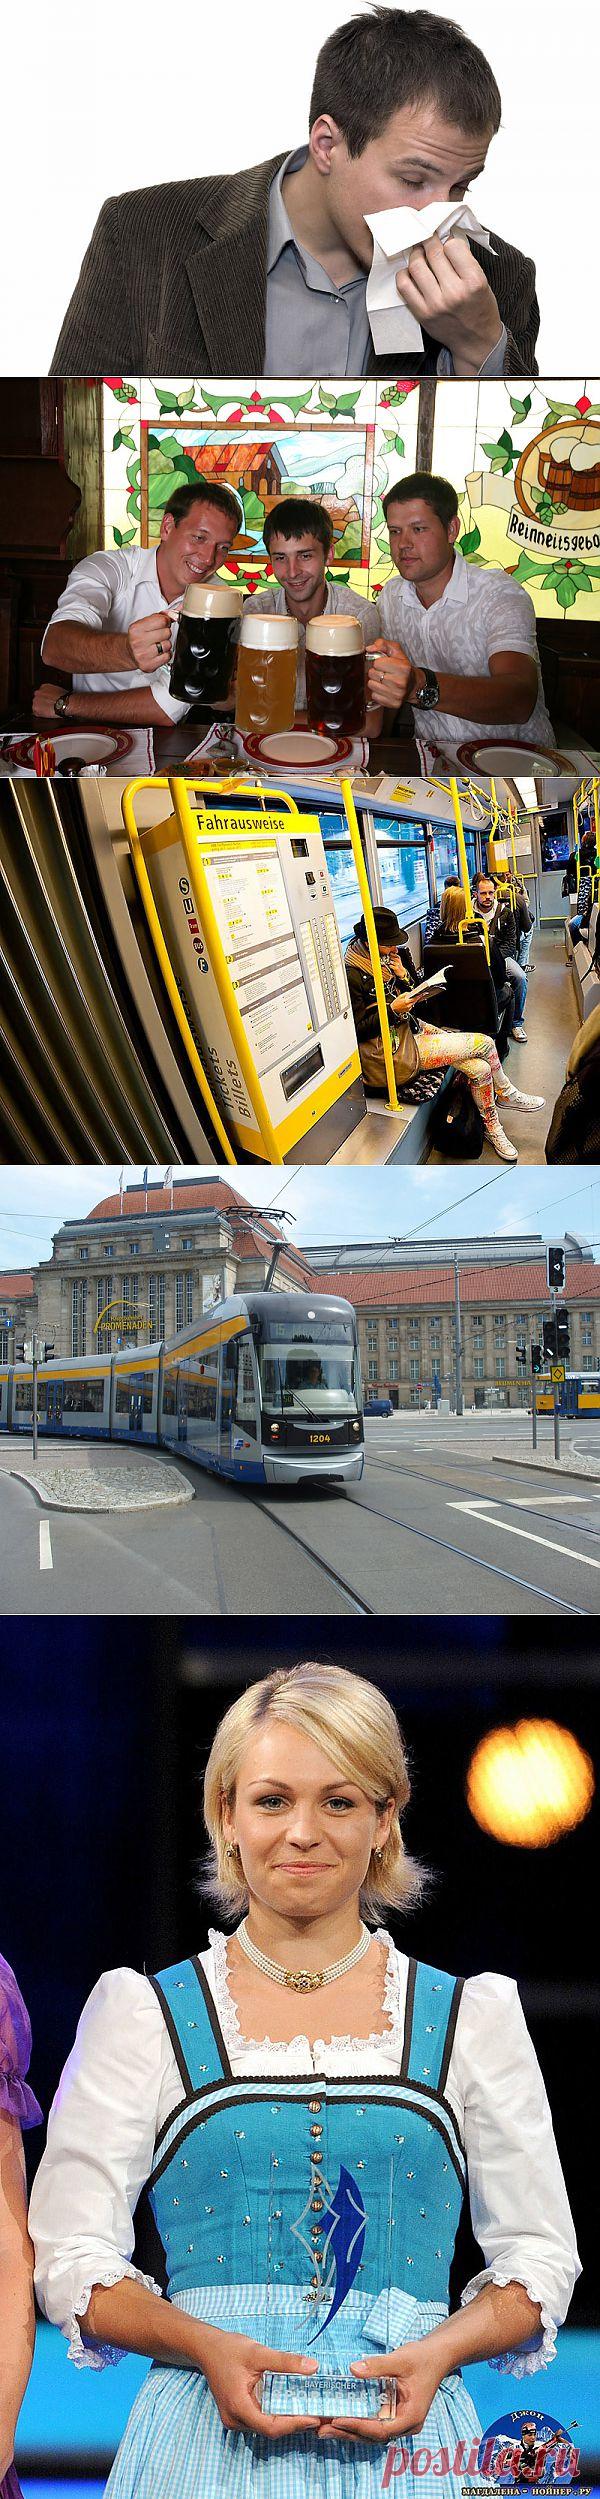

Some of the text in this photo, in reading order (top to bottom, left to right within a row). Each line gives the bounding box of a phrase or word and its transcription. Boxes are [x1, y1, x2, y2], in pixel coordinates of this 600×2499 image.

[196, 814, 285, 830] Fahrausweise
[185, 899, 192, 913] U
[208, 1047, 234, 1109] Tickets
[226, 1059, 251, 1118] Billets
[101, 1320, 153, 1331] PROMENADEN
[309, 1434, 331, 1443] 1204
[304, 2380, 357, 2390] BAYERISCHER
